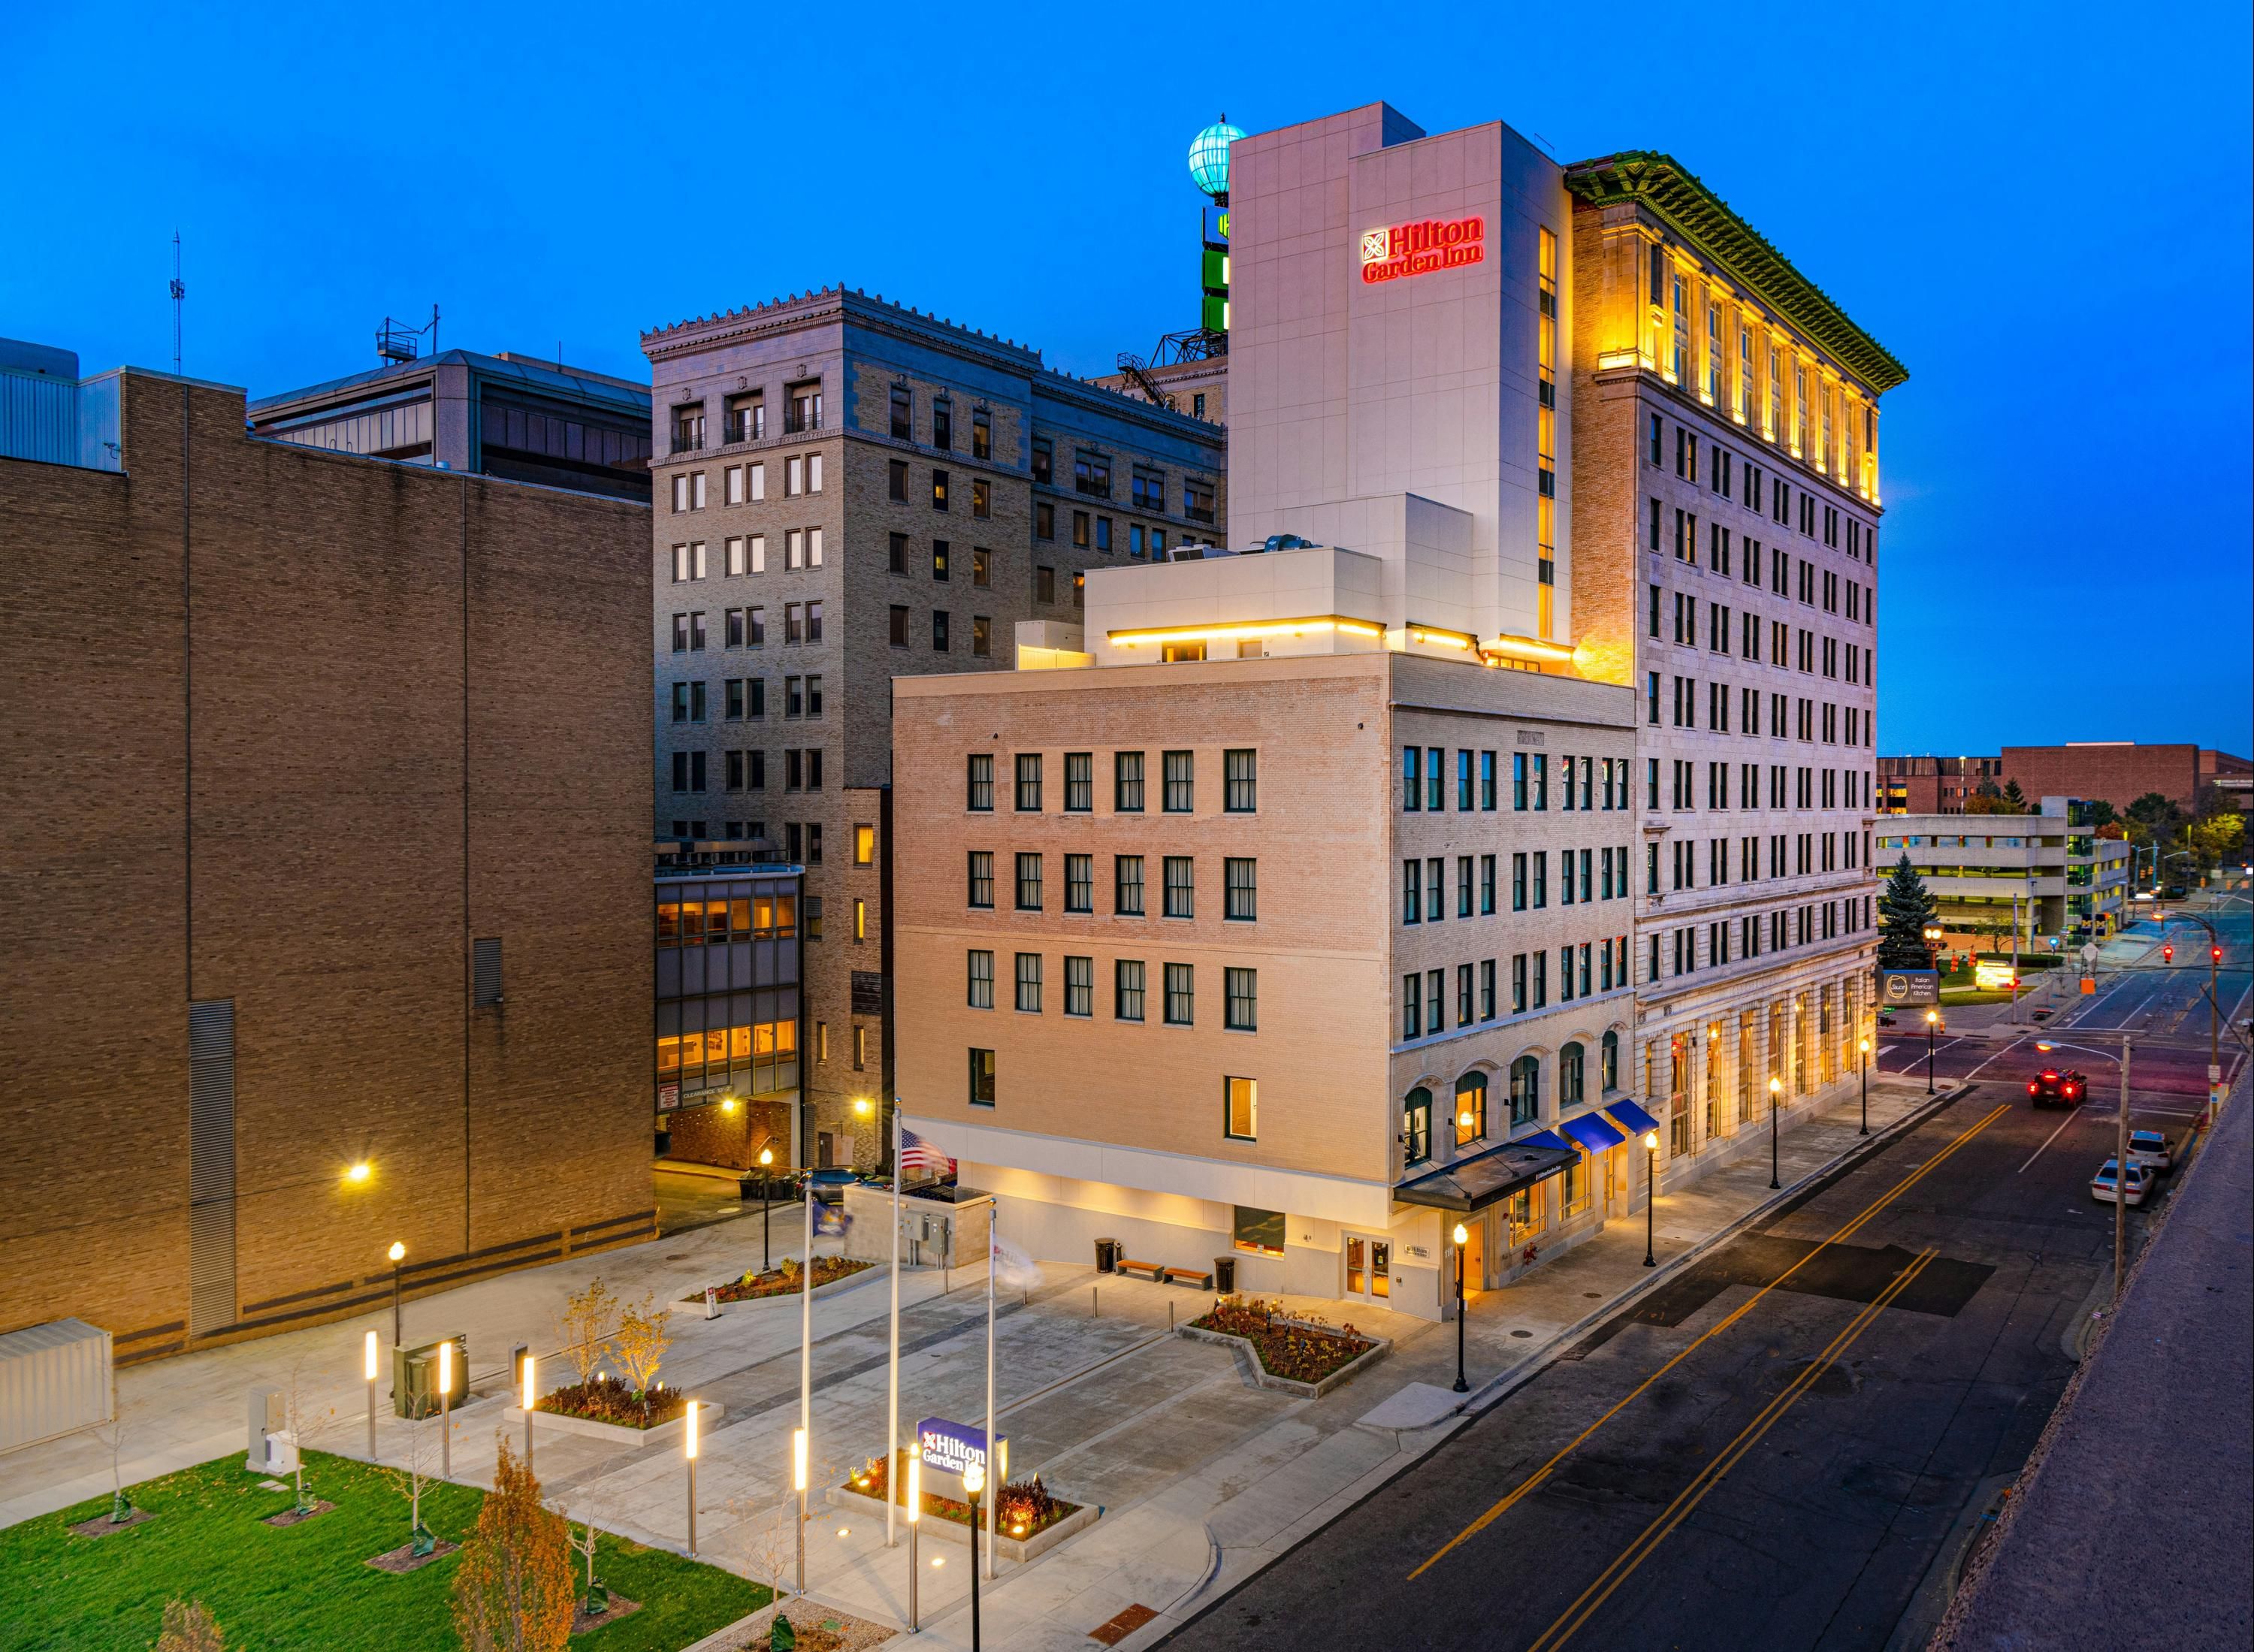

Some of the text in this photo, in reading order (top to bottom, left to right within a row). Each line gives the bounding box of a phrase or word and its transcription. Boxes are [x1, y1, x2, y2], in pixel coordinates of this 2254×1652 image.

[1388, 216, 1484, 258] Hilton
[1362, 245, 1484, 283] Garden Inn
[683, 1088, 715, 1098] CLEARANCE
[1411, 1246, 1428, 1254] Hilton
[922, 1448, 964, 1472] Garden
[935, 1433, 986, 1465] Hilton
